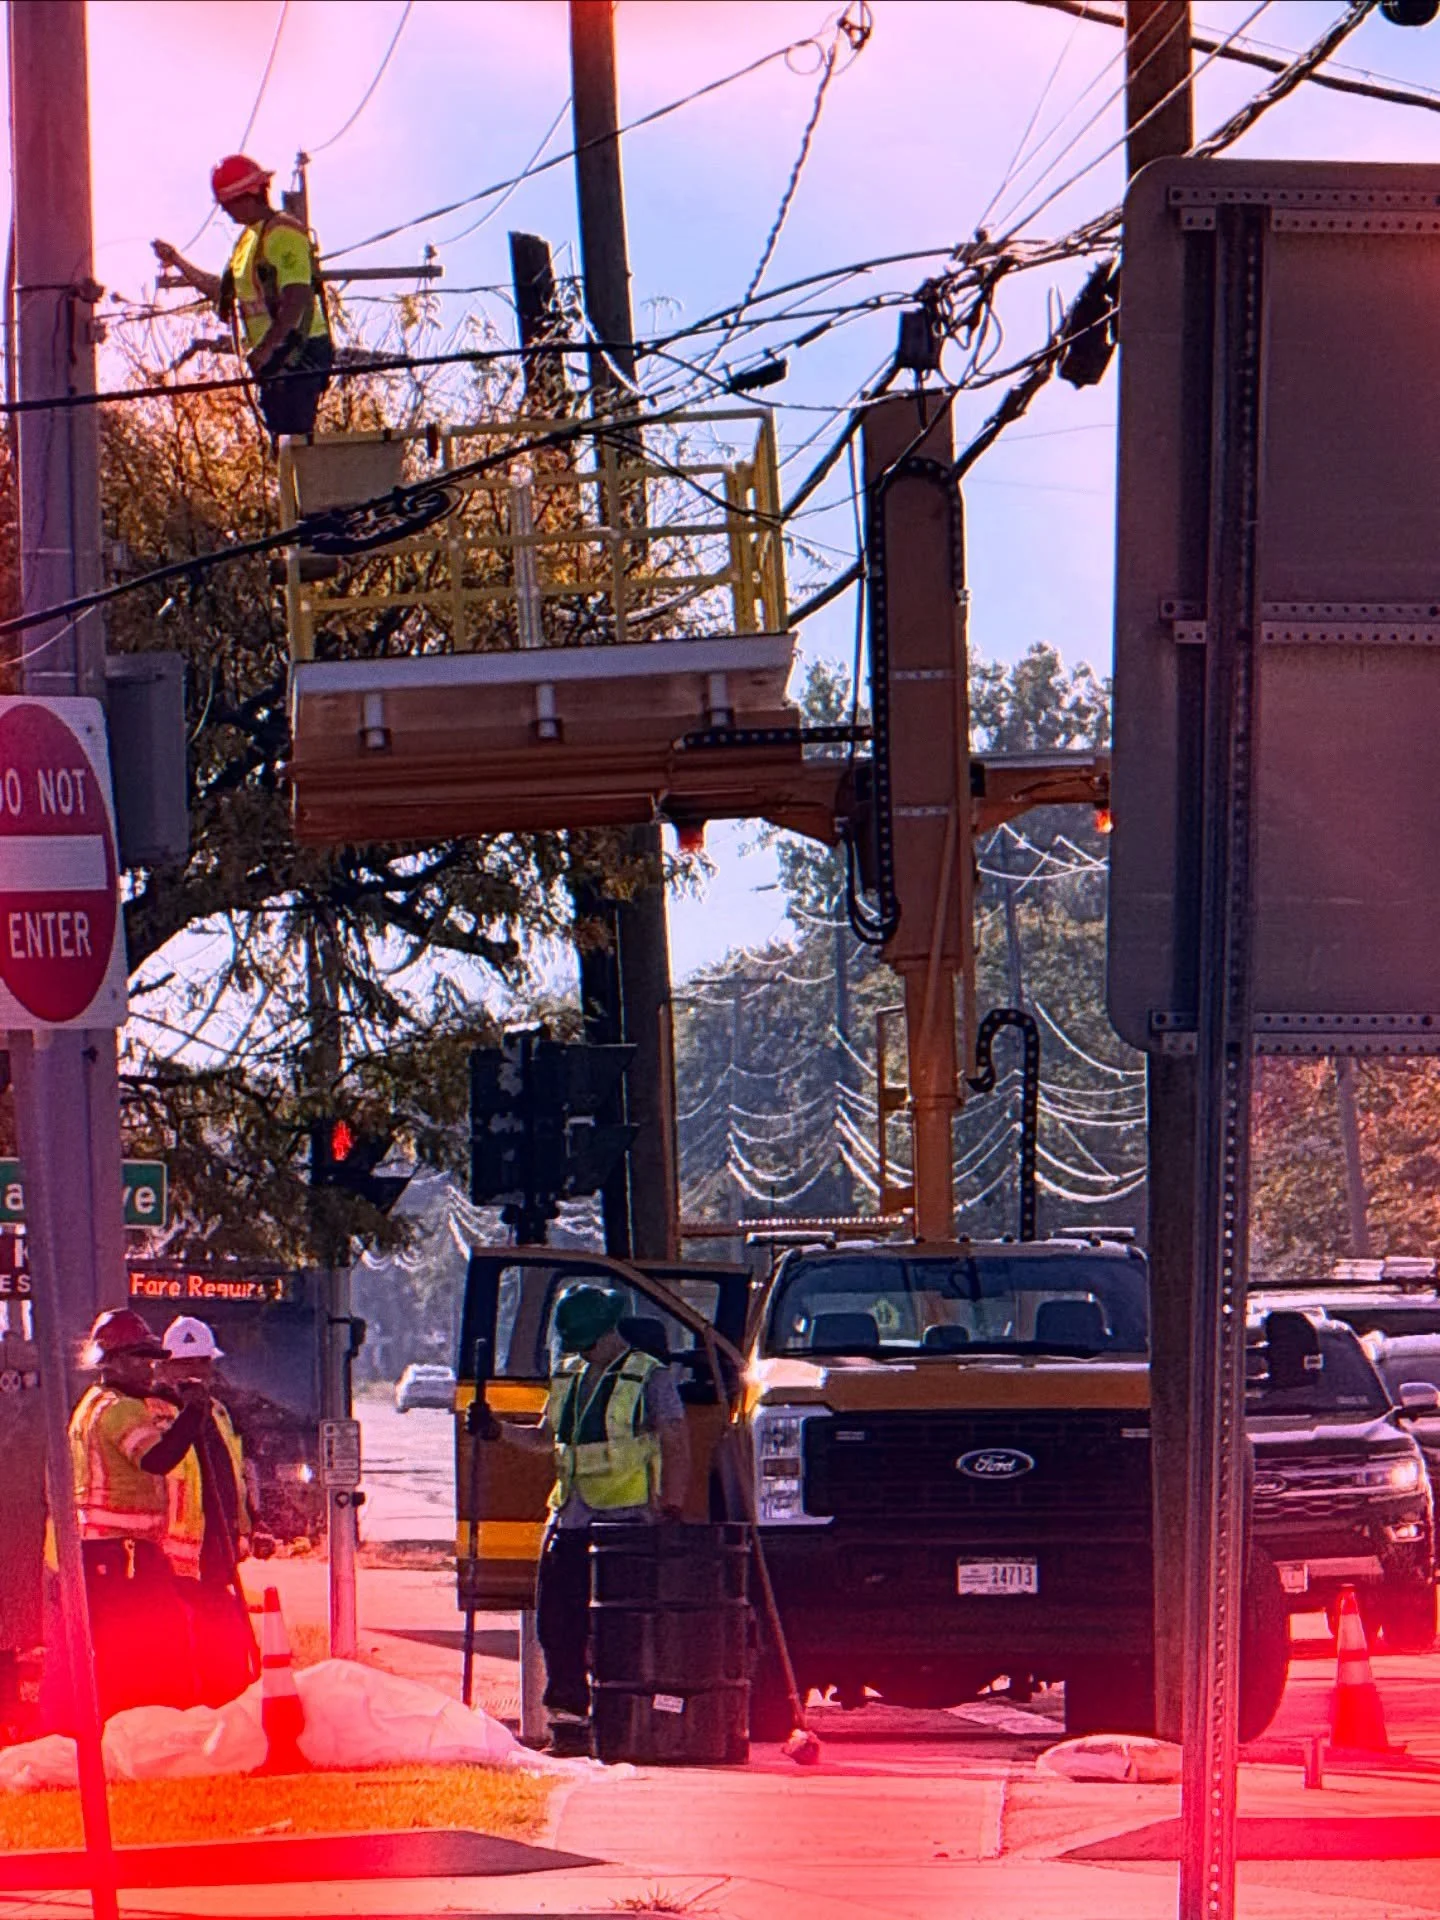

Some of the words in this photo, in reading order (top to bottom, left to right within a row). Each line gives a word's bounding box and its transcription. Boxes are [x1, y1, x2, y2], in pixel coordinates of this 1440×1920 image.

[0, 768, 21, 816] O
[38, 768, 86, 815] NOT
[9, 912, 92, 958] ENTER
[130, 1272, 181, 1295] Fare
[975, 1454, 1016, 1472] Ford
